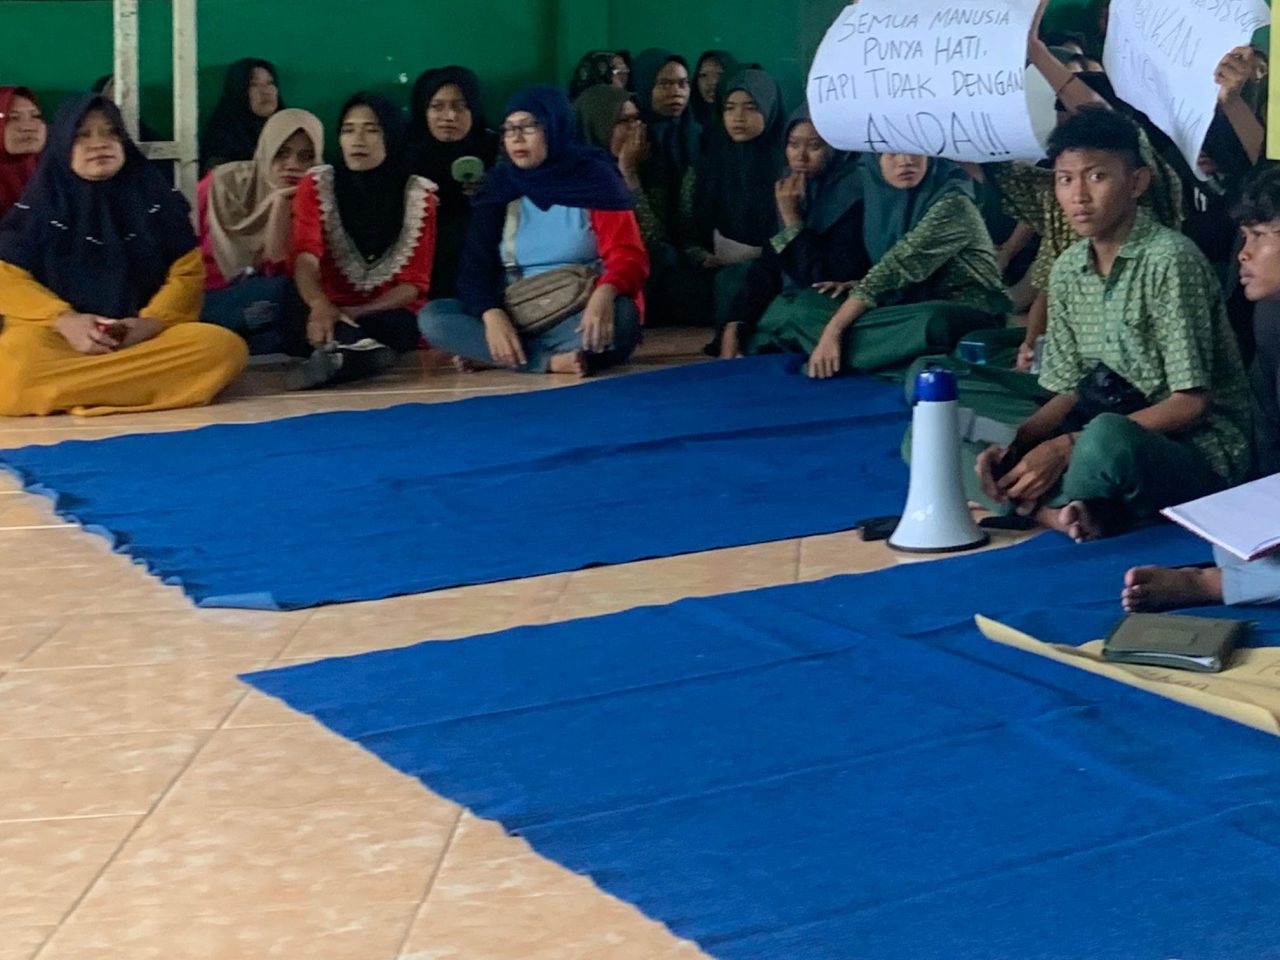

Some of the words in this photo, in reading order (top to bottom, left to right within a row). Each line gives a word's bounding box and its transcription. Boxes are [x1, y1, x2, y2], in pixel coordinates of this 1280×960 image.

[838, 12, 919, 42] SEMUA
[928, 7, 1010, 31] MANUSIA
[863, 36, 924, 66] PUNYA
[813, 73, 857, 104] TAPI
[863, 67, 936, 100] TIDAK
[952, 67, 1025, 98] DENGAN
[863, 110, 1011, 156] ANDA!!!
